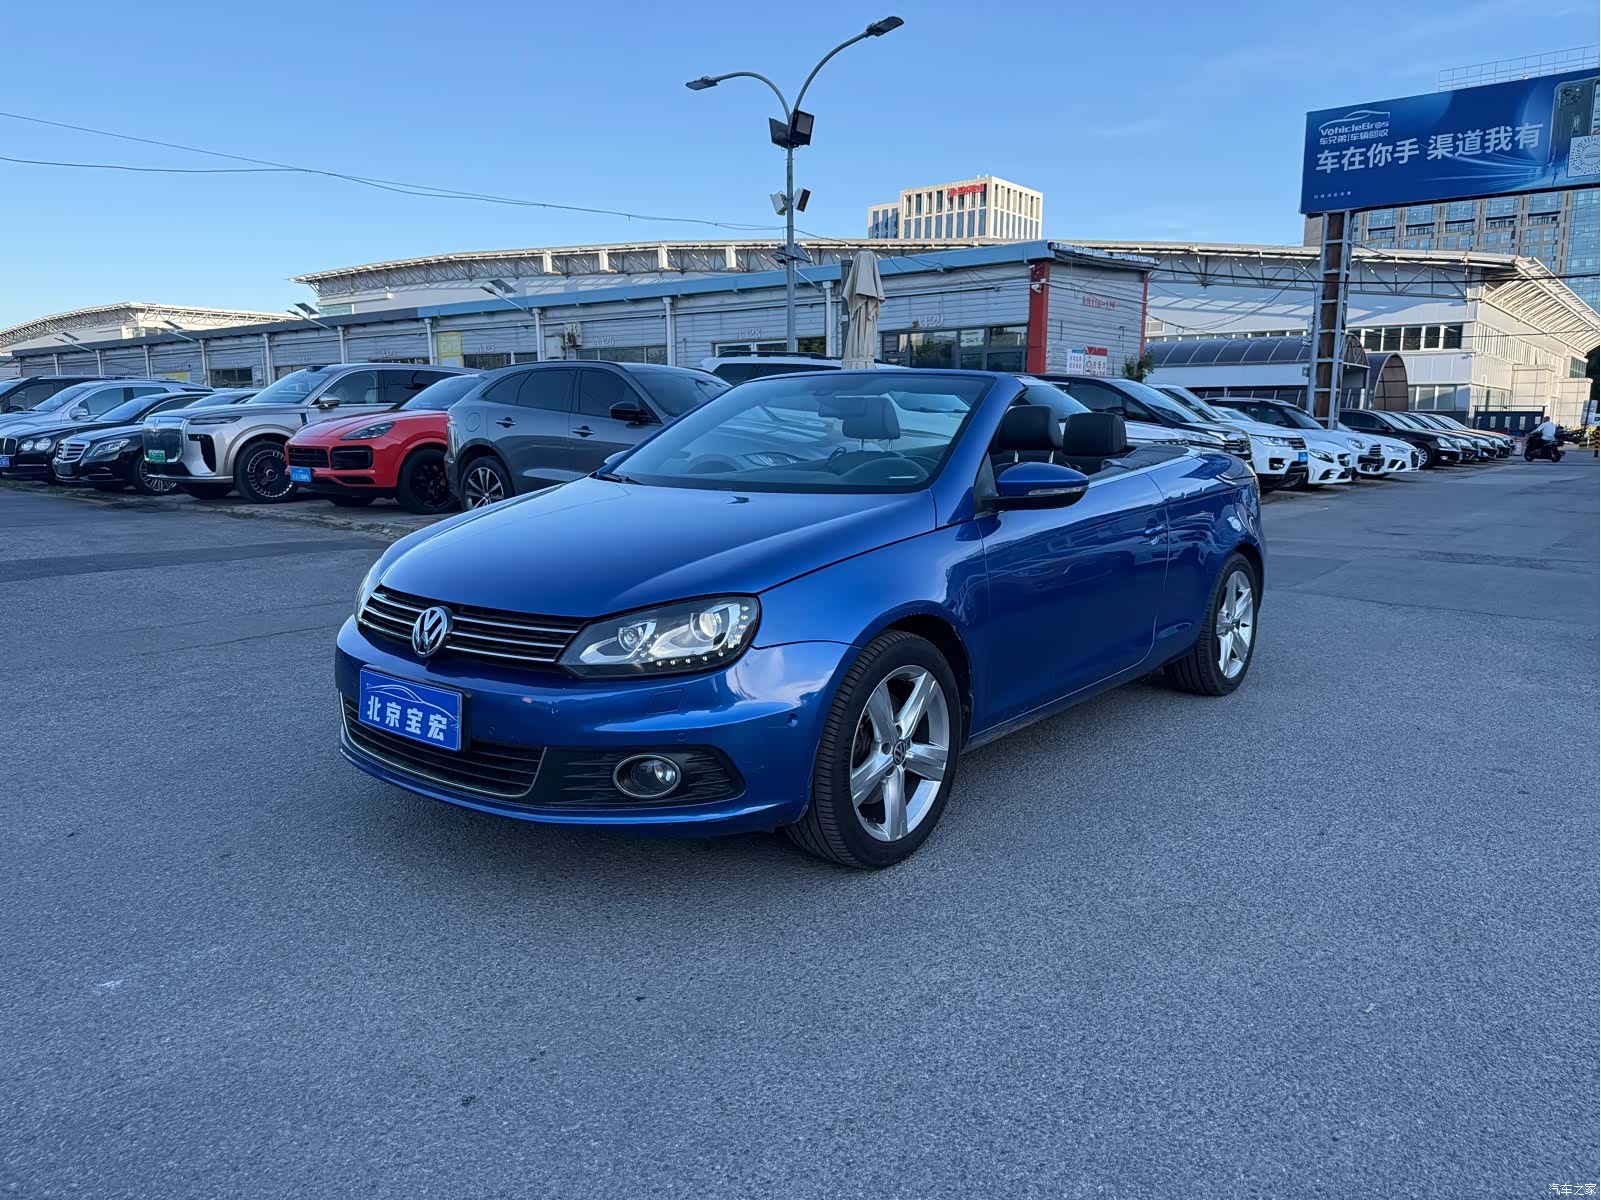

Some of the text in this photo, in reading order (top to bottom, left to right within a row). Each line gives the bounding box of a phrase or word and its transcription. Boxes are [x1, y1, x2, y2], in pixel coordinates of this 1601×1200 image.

[1315, 122, 1544, 174] 车在你手 渠道我有
[1320, 121, 1390, 136] VehicleBros
[366, 694, 448, 742] 北京宝宏
